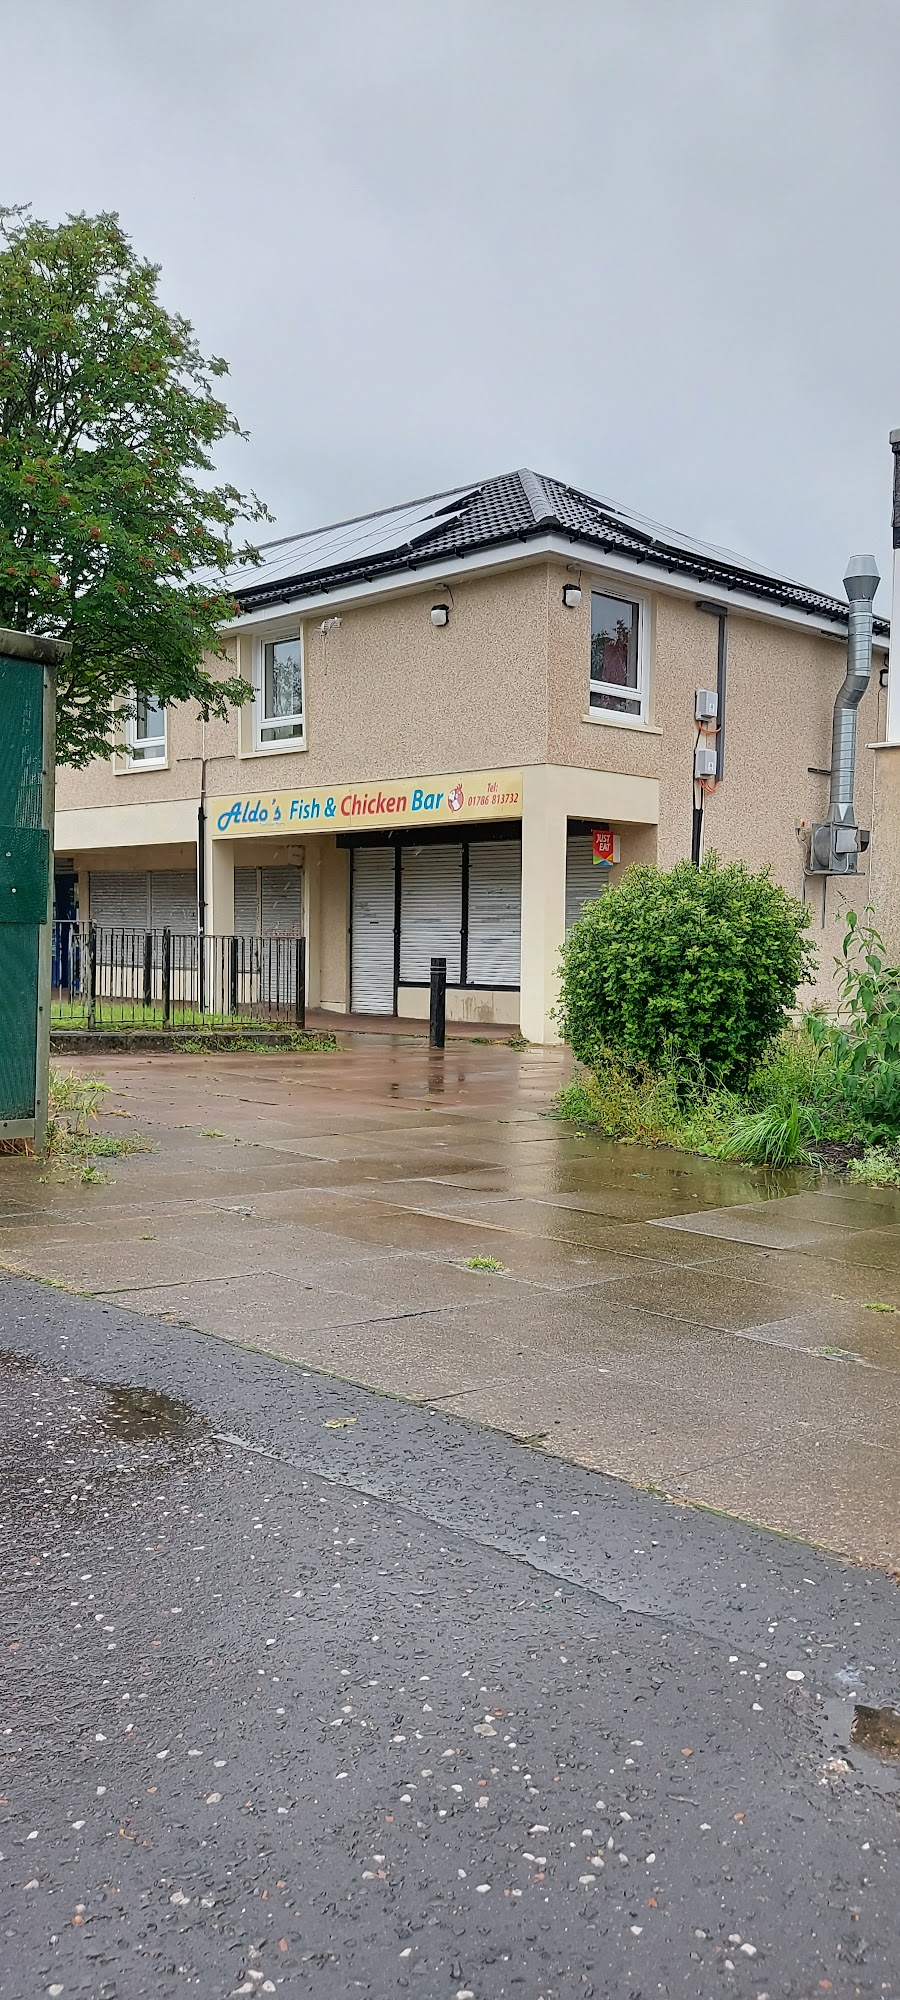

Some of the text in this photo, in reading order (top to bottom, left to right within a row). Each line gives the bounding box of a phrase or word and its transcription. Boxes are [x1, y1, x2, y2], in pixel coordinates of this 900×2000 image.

[487, 782, 499, 793] Tel:
[467, 792, 519, 807] 01786 813732
[217, 789, 444, 831] Aldo's Fish & Chicken Bar
[596, 834, 611, 843] JUST
[599, 843, 611, 851] EAT
